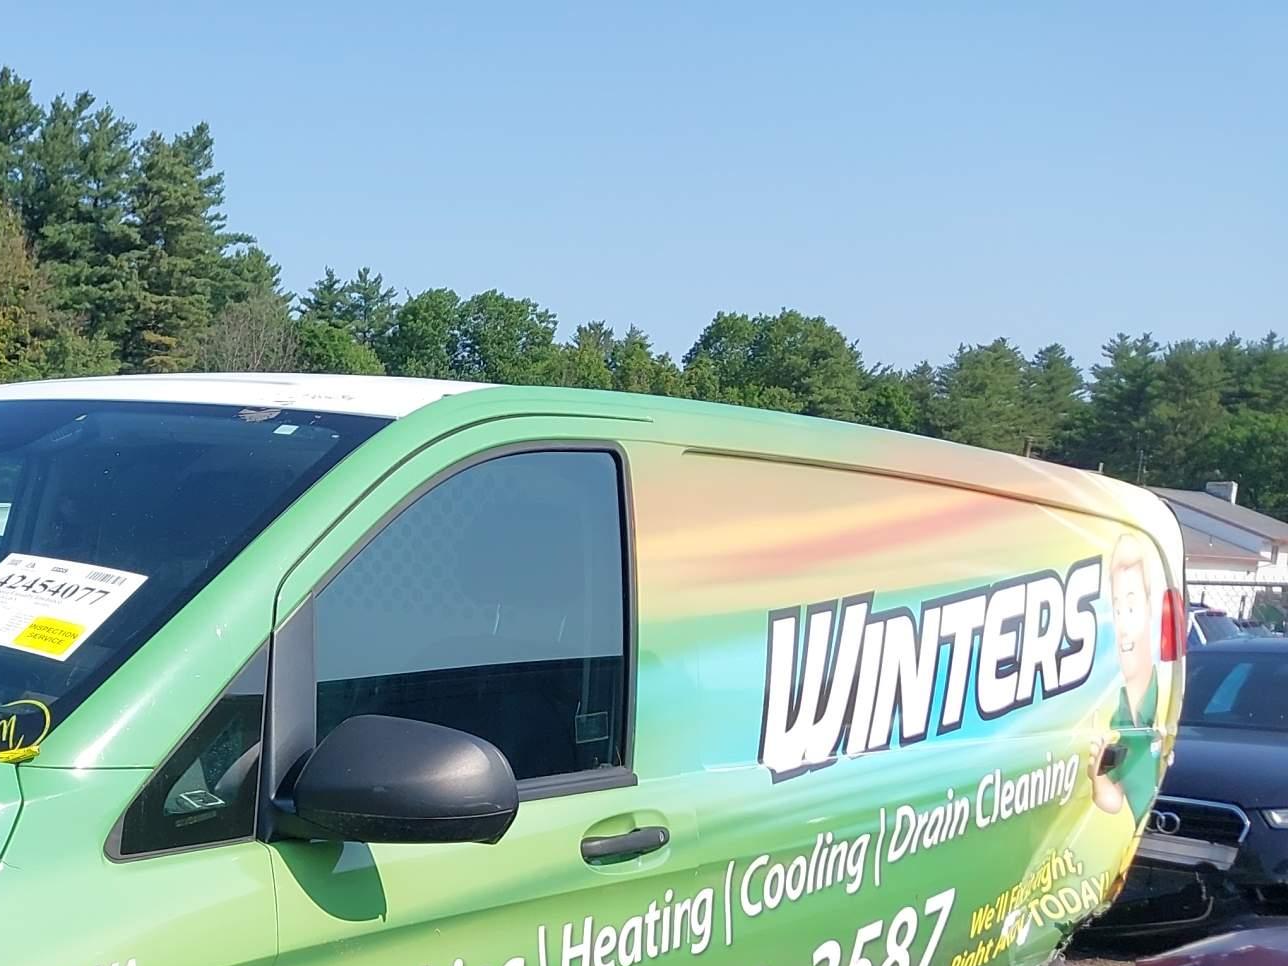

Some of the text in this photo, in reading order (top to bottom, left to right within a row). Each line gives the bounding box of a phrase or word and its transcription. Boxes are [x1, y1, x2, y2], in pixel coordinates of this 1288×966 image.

[27, 632, 65, 646] SERVICE
[29, 623, 79, 640] INSPECTION
[759, 556, 1102, 783] WINTERS
[740, 823, 869, 917] Cooling
[888, 788, 971, 863] Drain
[975, 752, 1079, 829] Cleaning
[970, 892, 1009, 939] We'll
[1028, 871, 1110, 928] TODAY!
